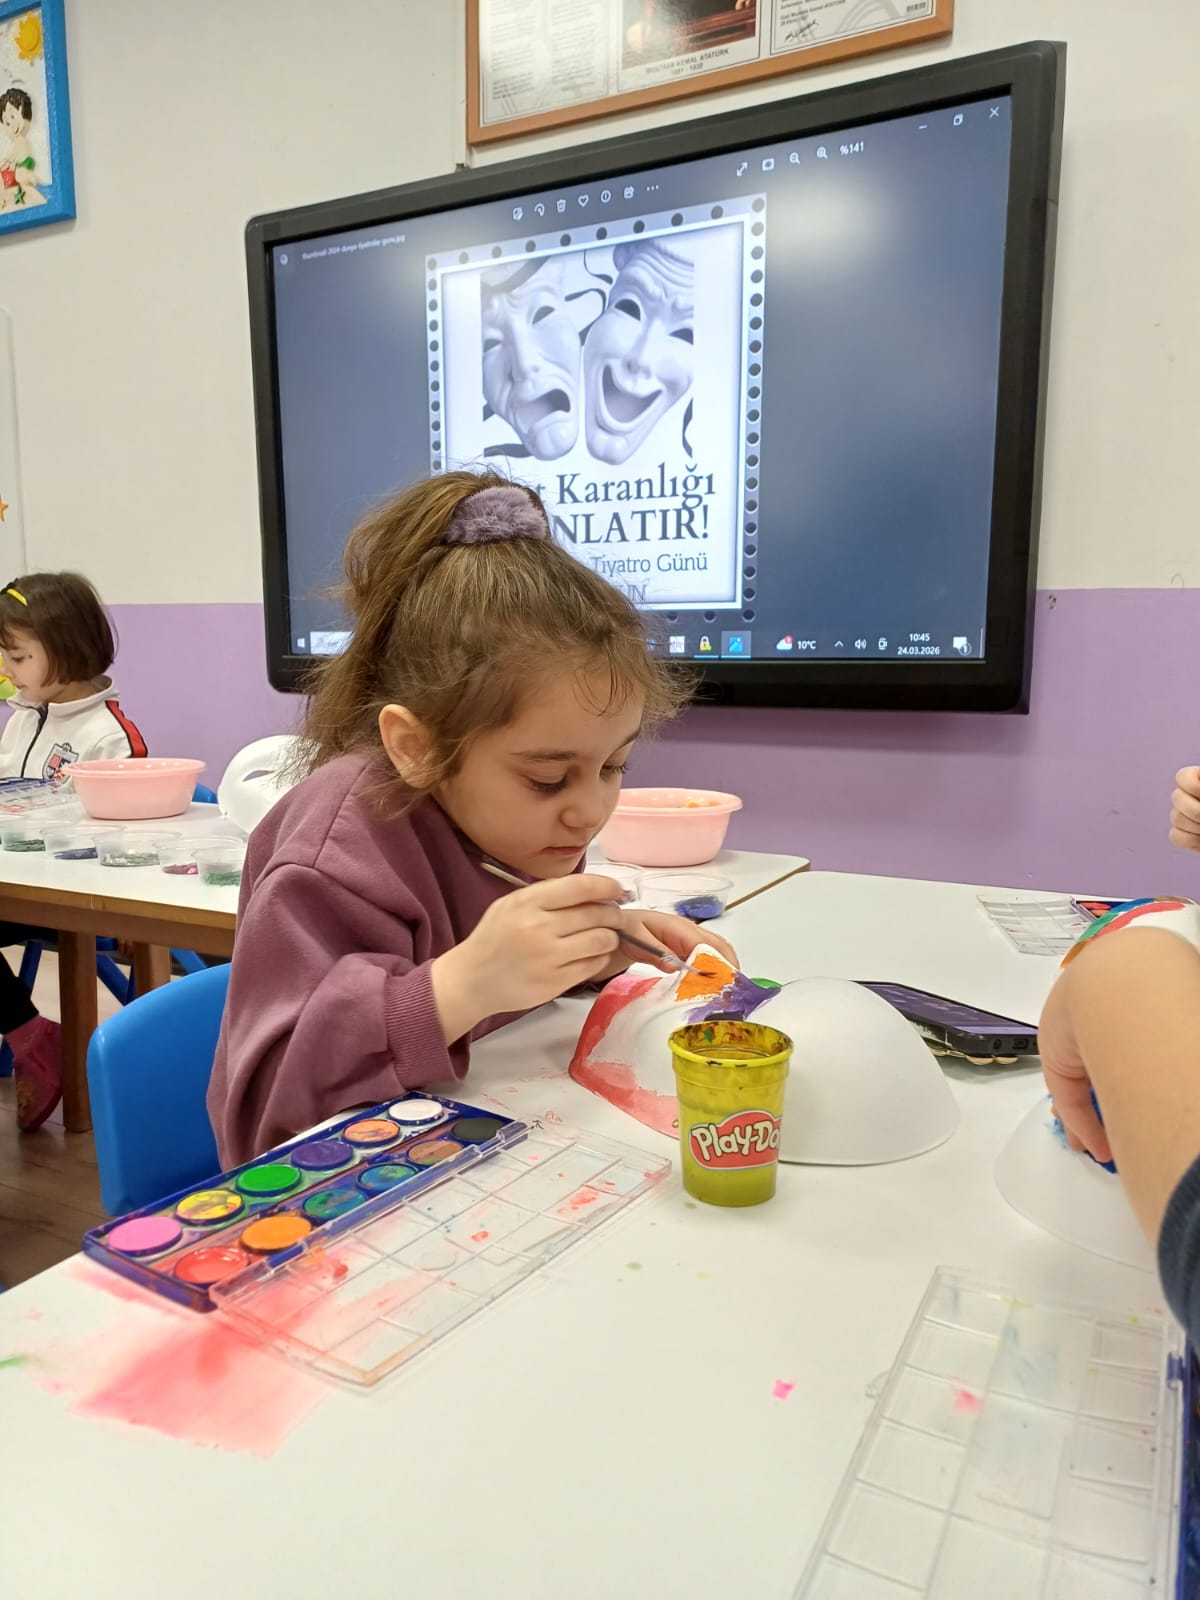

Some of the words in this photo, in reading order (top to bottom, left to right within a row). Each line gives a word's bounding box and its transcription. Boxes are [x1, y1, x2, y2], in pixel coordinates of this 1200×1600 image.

[839, 141, 864, 156] %141
[555, 461, 716, 510] Karanlığı
[552, 504, 709, 545] NLATIR!
[590, 554, 651, 577] Tiyatro
[657, 552, 708, 573] Günü
[797, 639, 817, 650] 10°C
[909, 632, 930, 642] 10:45
[897, 645, 940, 655] 24.03.2026
